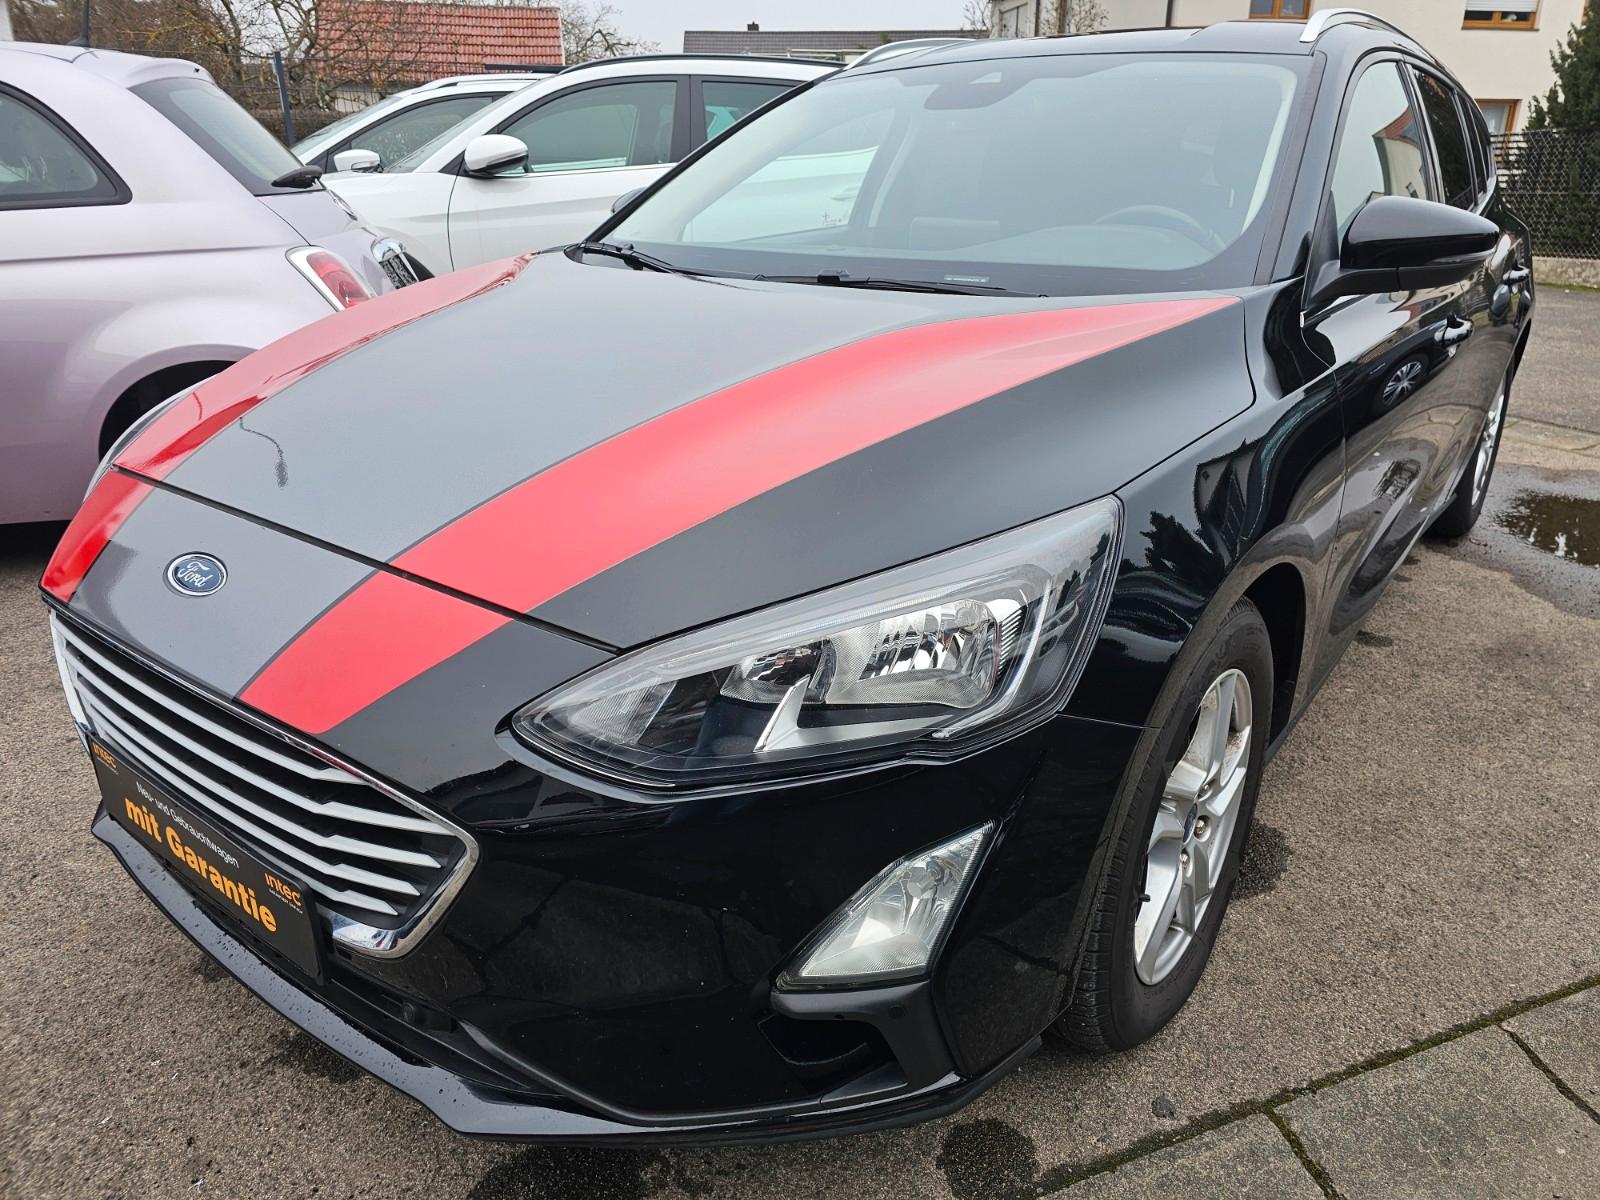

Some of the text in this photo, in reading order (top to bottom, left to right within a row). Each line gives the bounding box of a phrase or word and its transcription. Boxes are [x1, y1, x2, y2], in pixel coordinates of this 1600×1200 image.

[177, 561, 214, 588] Ford
[124, 797, 277, 933] mit Garantie
[155, 798, 170, 817] und
[169, 808, 240, 869] Gebrauchtwagen
